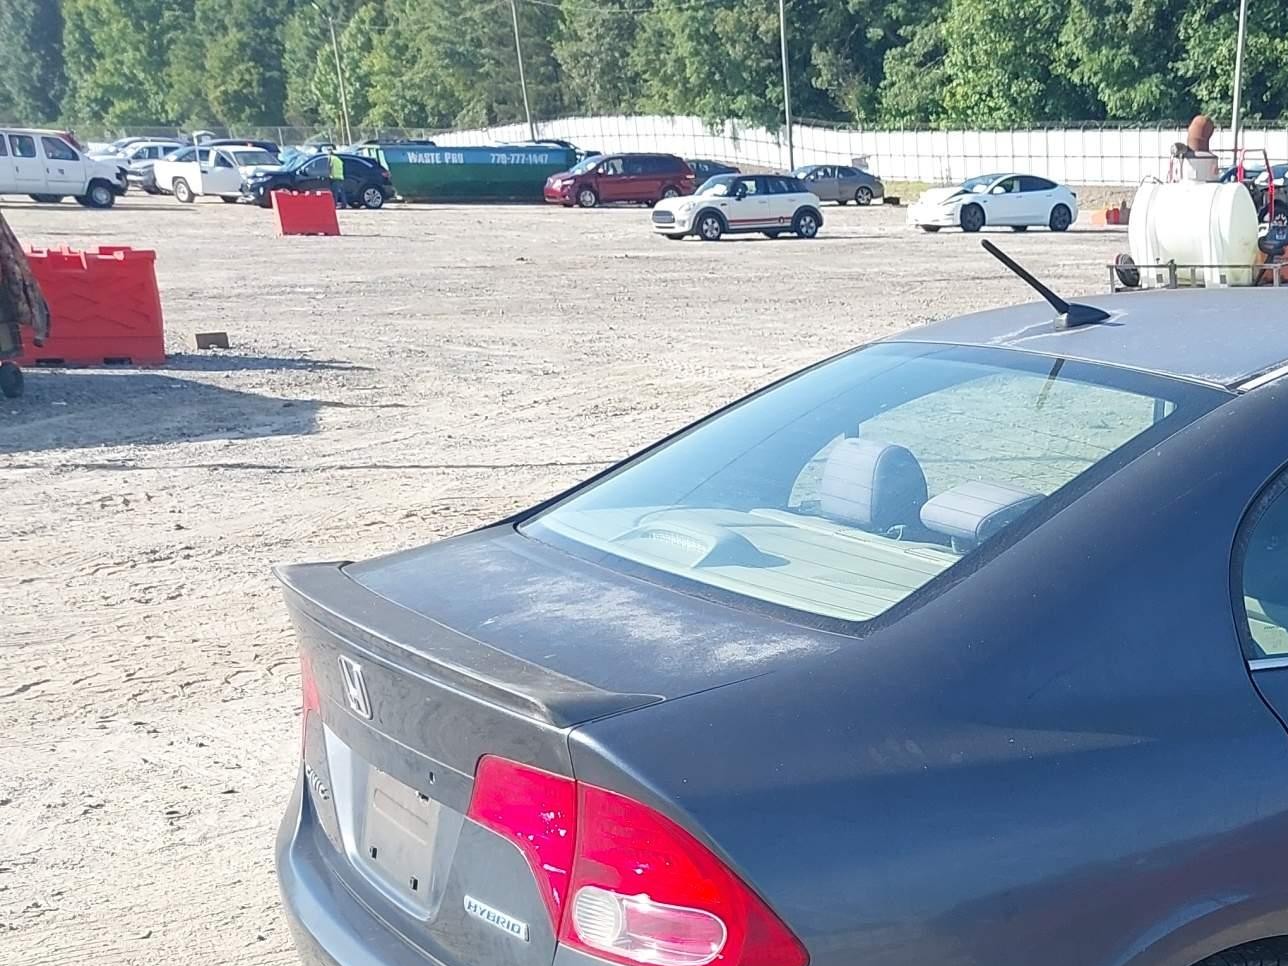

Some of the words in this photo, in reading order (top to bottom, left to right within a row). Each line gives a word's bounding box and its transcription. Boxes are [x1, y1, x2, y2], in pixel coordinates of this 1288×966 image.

[407, 151, 442, 164] WASTE
[444, 151, 464, 164] PRO
[466, 899, 523, 936] HYBRID
